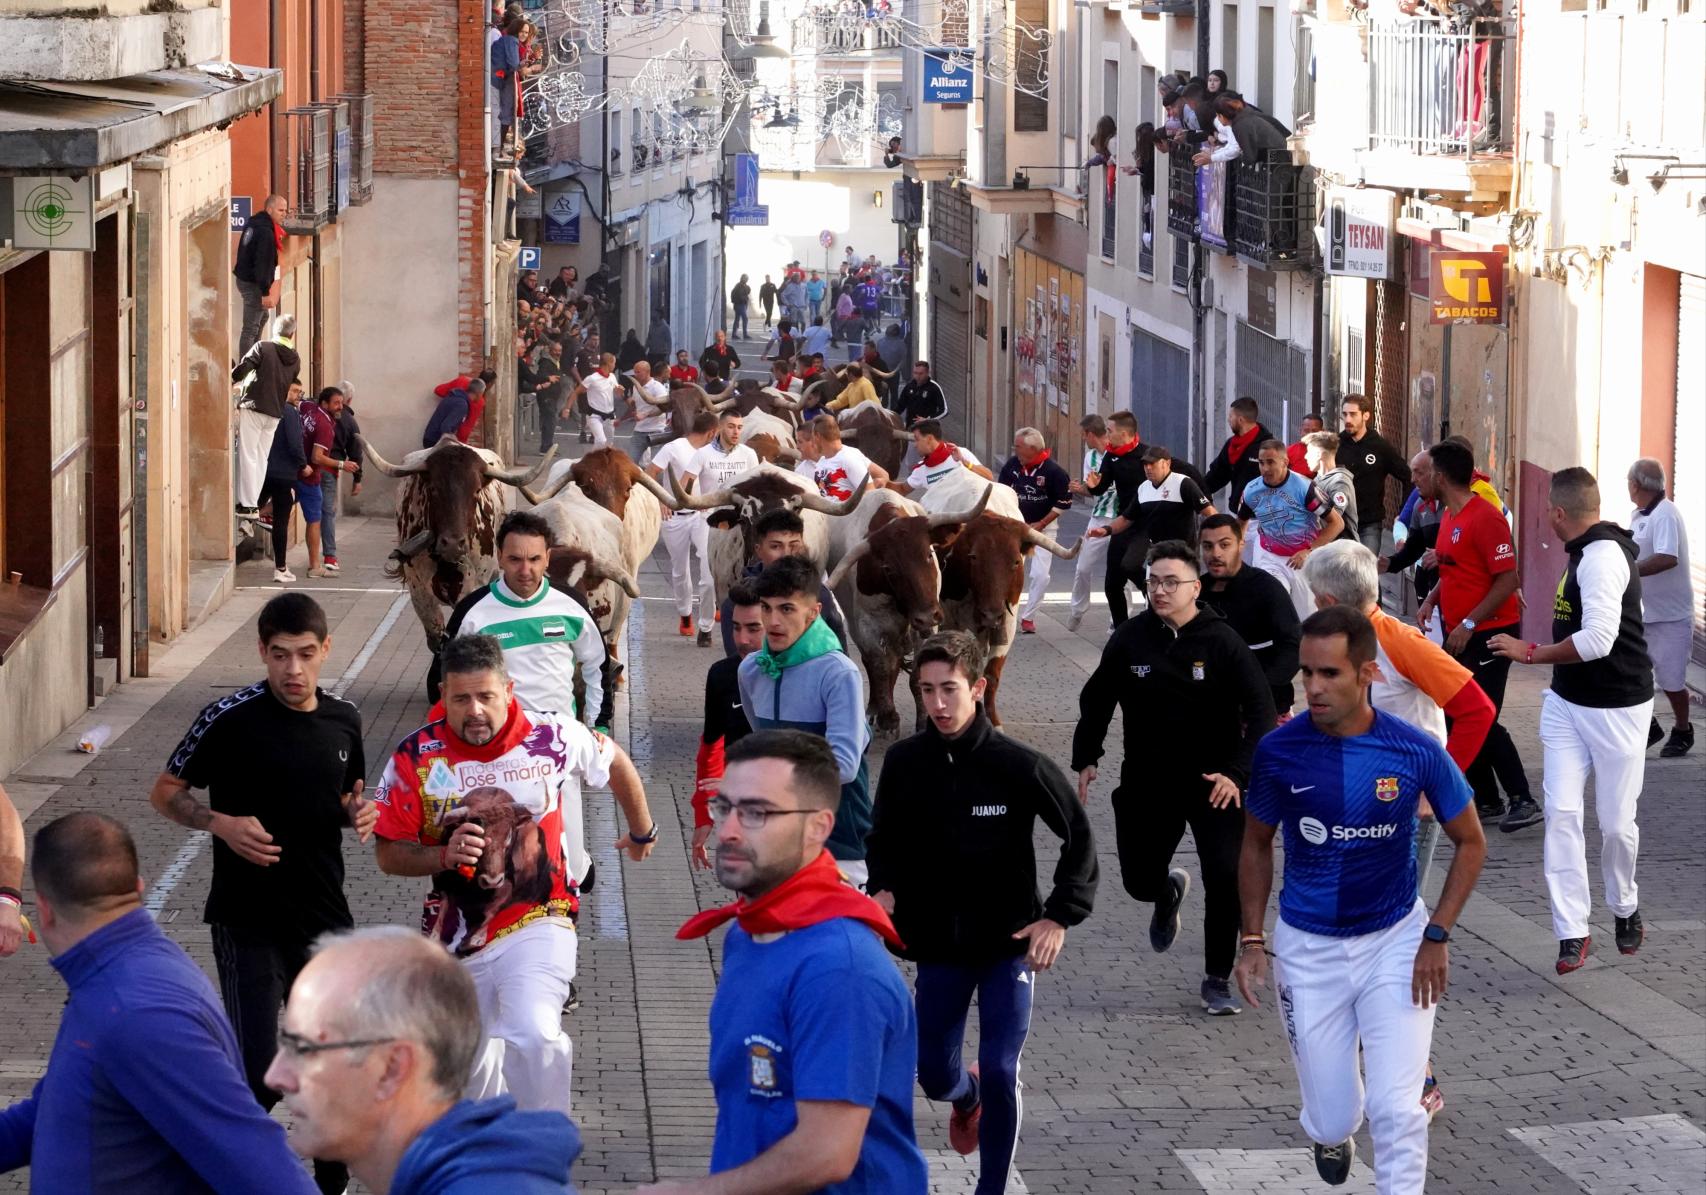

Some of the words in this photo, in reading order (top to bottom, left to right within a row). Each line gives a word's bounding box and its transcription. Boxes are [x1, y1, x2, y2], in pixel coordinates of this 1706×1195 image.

[930, 77, 968, 87] Allianz
[936, 91, 961, 99] Seguros
[1348, 224, 1384, 250] TEYSAN
[522, 249, 536, 267] P
[1434, 307, 1498, 318] TABACOS
[462, 757, 527, 776] maderas
[458, 767, 497, 793] Jose
[504, 760, 551, 783] maría
[971, 805, 1007, 816] JUANJO
[1331, 823, 1398, 841] Spotify
